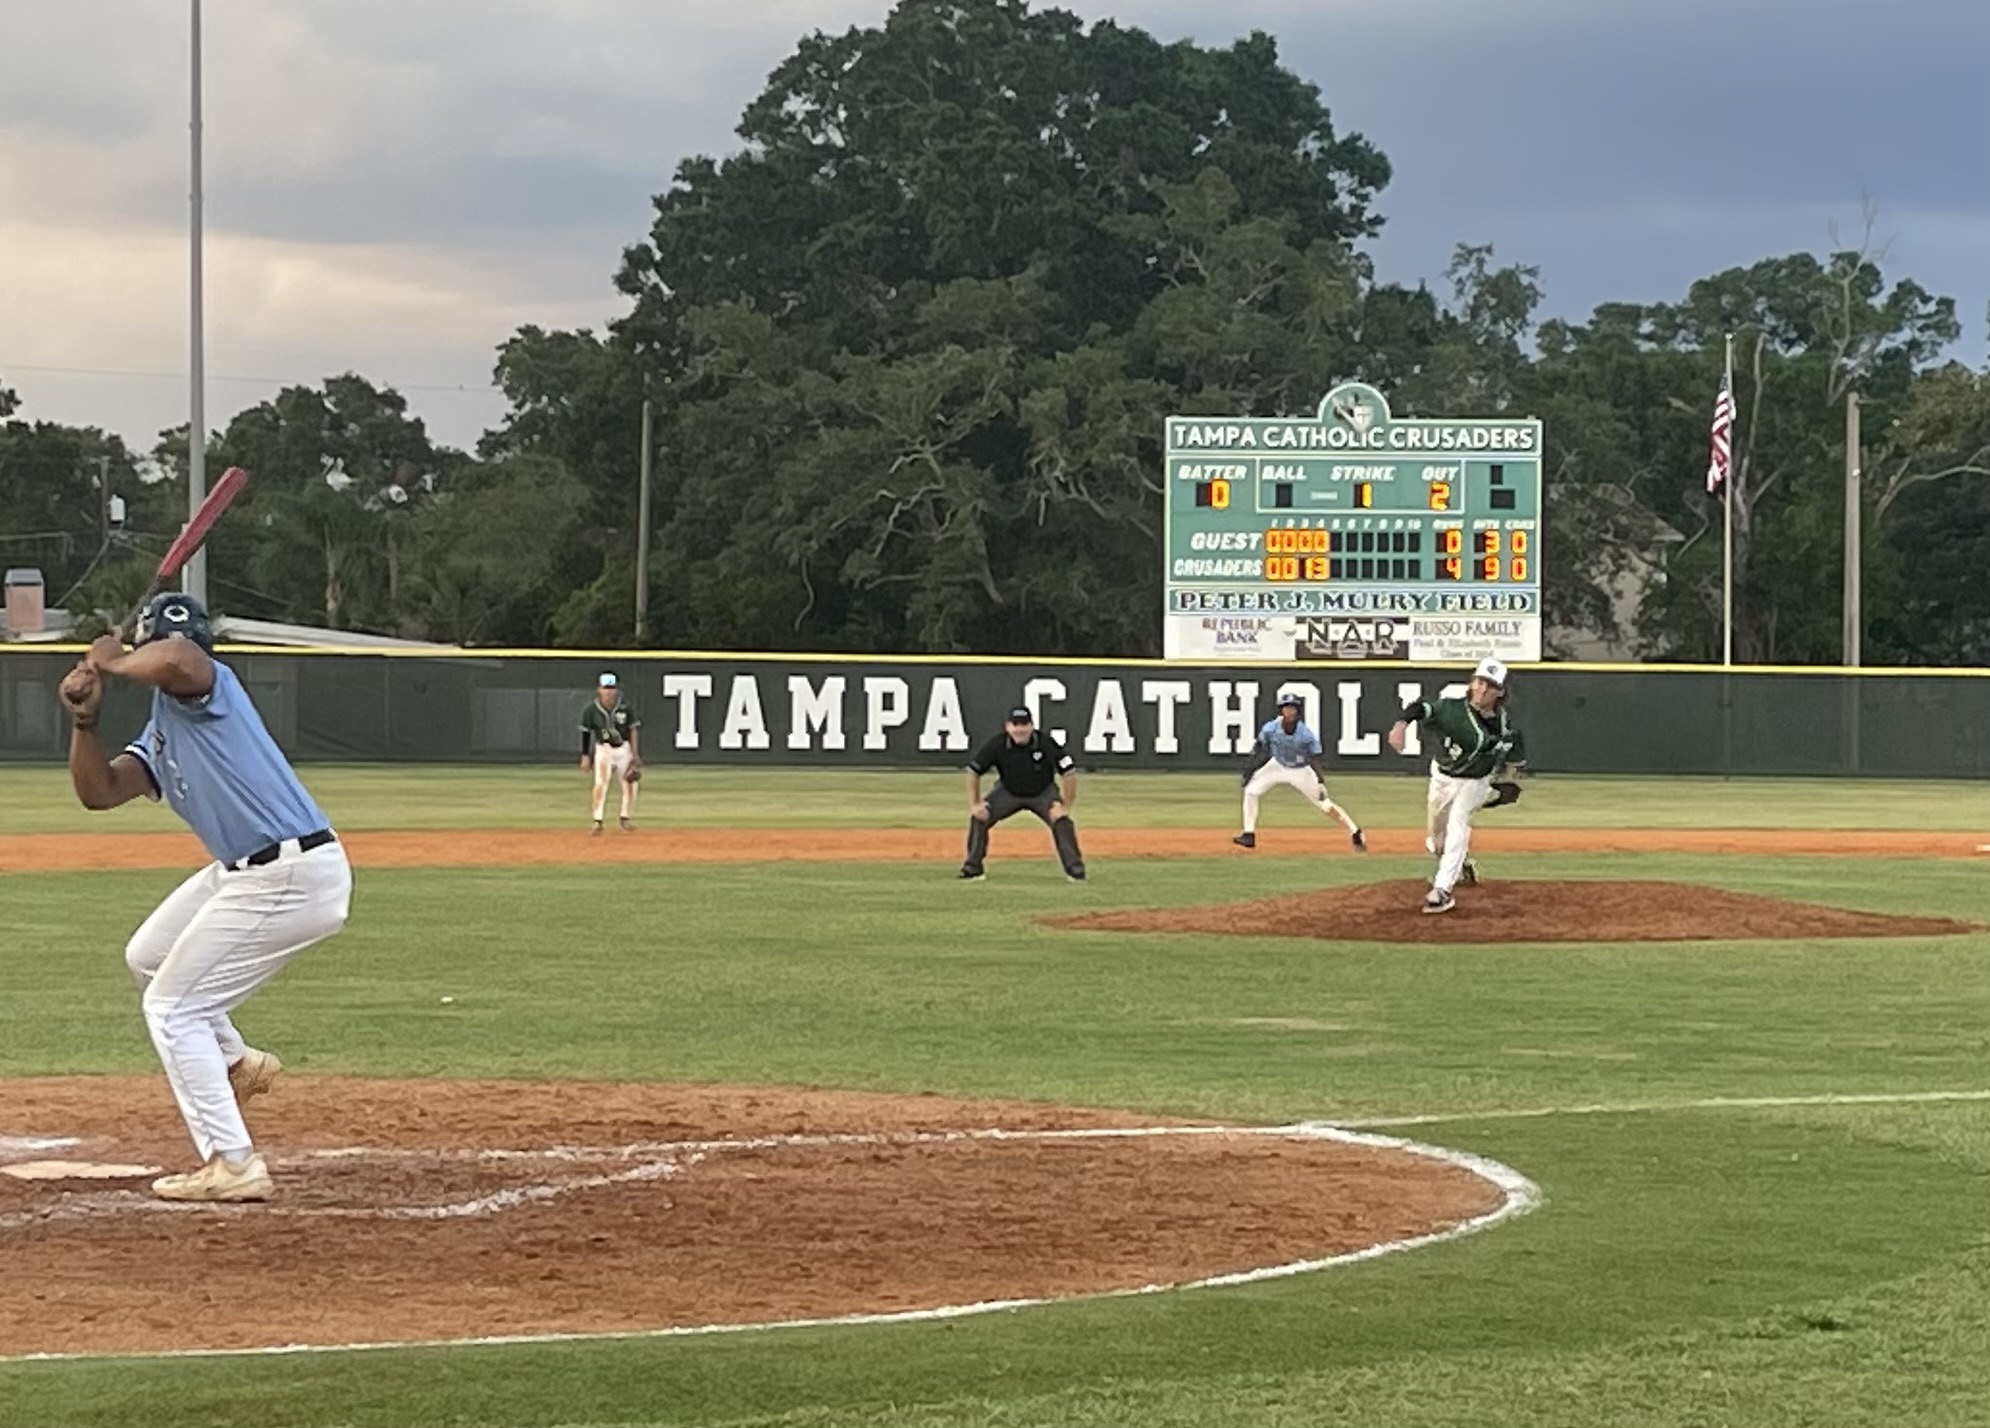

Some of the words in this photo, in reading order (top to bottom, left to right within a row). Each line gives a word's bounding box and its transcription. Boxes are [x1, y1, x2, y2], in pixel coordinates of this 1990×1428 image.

[1175, 425, 1257, 447] TAMPA
[1263, 426, 1385, 448] CATHOLIC
[1389, 427, 1533, 449] CRUSADERS
[1178, 465, 1248, 480] BATTER
[1262, 465, 1307, 480] BALL
[1330, 465, 1397, 481] STRIKE
[1421, 466, 1459, 481] OUT
[1430, 481, 1450, 510] 2
[1190, 532, 1262, 550] GUEST
[1174, 559, 1263, 576] CRUSADERS
[1176, 590, 1280, 612] PETER
[1318, 590, 1432, 613] MULRY
[1436, 591, 1532, 613] FIELD
[1412, 621, 1461, 636] RUSSO
[1465, 621, 1522, 636] FAMILY
[1216, 631, 1258, 644] BANK
[663, 674, 970, 750] TAMPA
